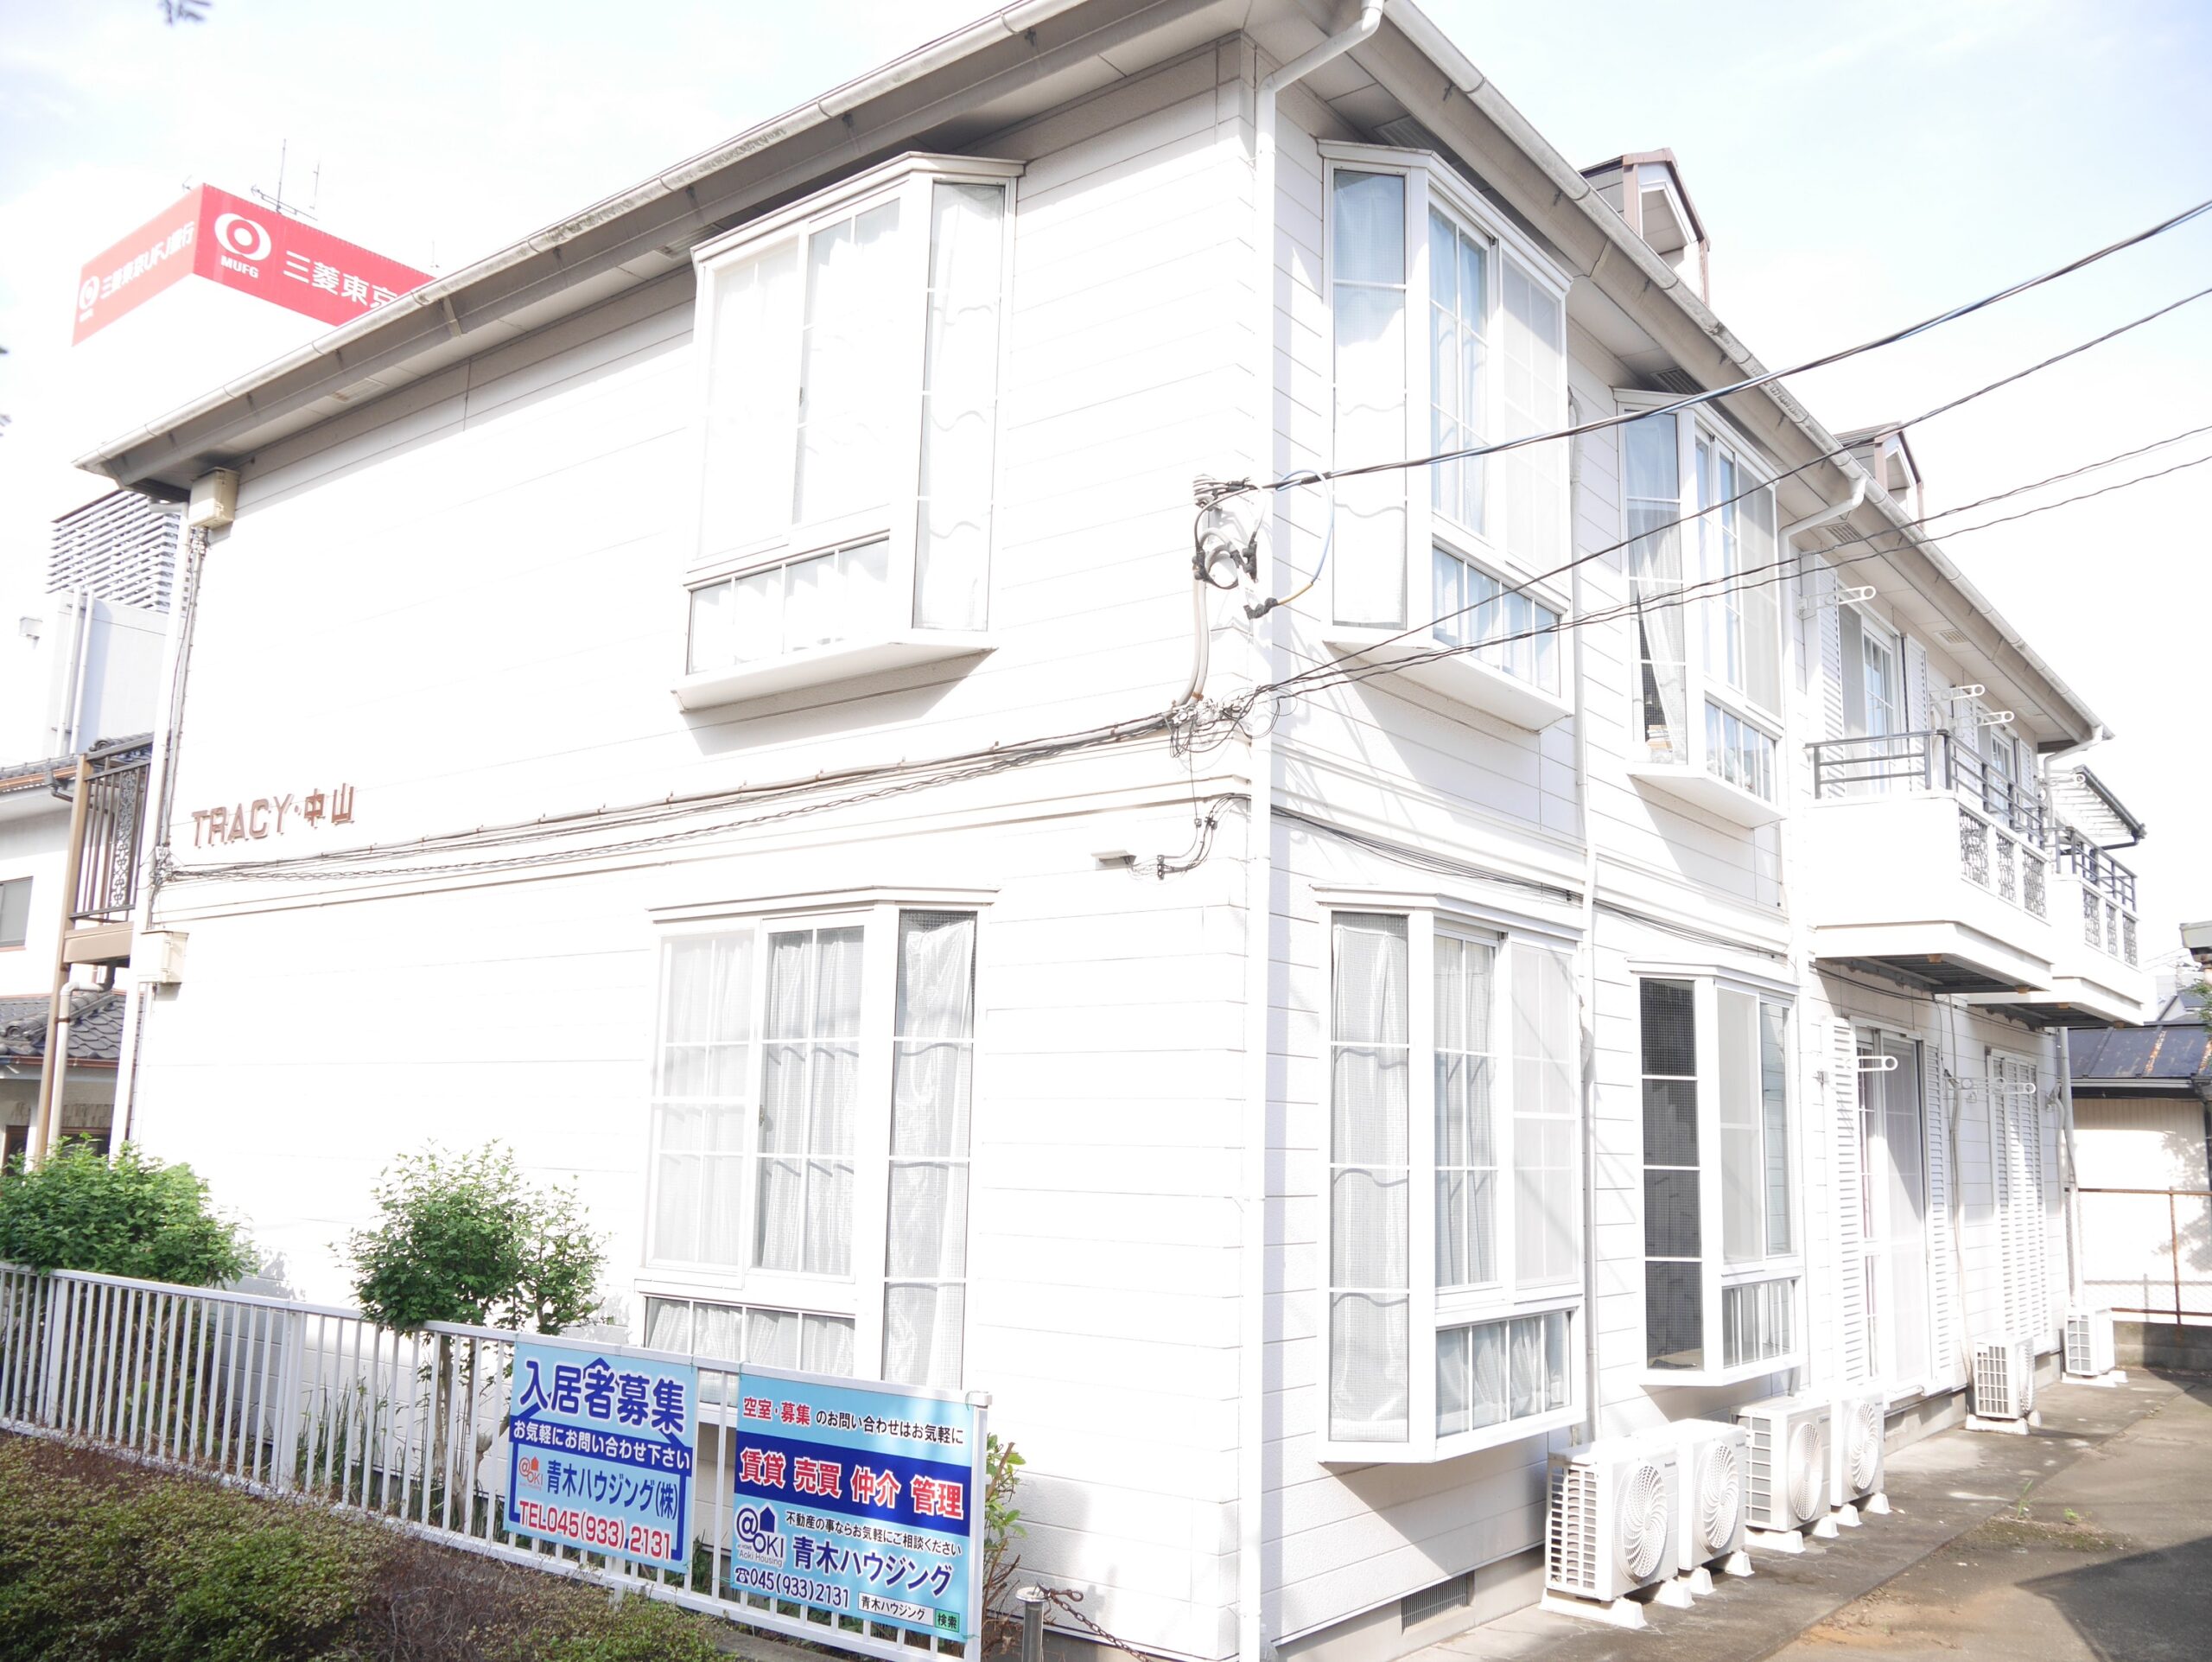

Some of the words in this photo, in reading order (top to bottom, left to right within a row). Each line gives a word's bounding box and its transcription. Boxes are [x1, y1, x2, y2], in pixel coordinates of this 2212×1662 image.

[220, 254, 259, 279] MUFG
[519, 1360, 684, 1434] 入居者募集
[513, 1421, 690, 1469] お気軽にお問い合わせ下さい
[816, 1410, 964, 1444] のお問い合わせはお気軽に
[547, 1460, 678, 1519] 青木ハウジング(株)
[741, 1449, 786, 1487] 賃貸
[795, 1458, 841, 1497] 売買
[851, 1466, 900, 1506] 仲介
[911, 1475, 963, 1519] 管理
[785, 1511, 962, 1556] 不動産の事ならお気軽にご相談ください
[739, 1550, 753, 1558] Aoki
[755, 1553, 783, 1568] Housing
[792, 1536, 953, 1597] 青木ハウジング
[861, 1595, 925, 1621] 青木ハウジング
[937, 1613, 957, 1630] 検索
